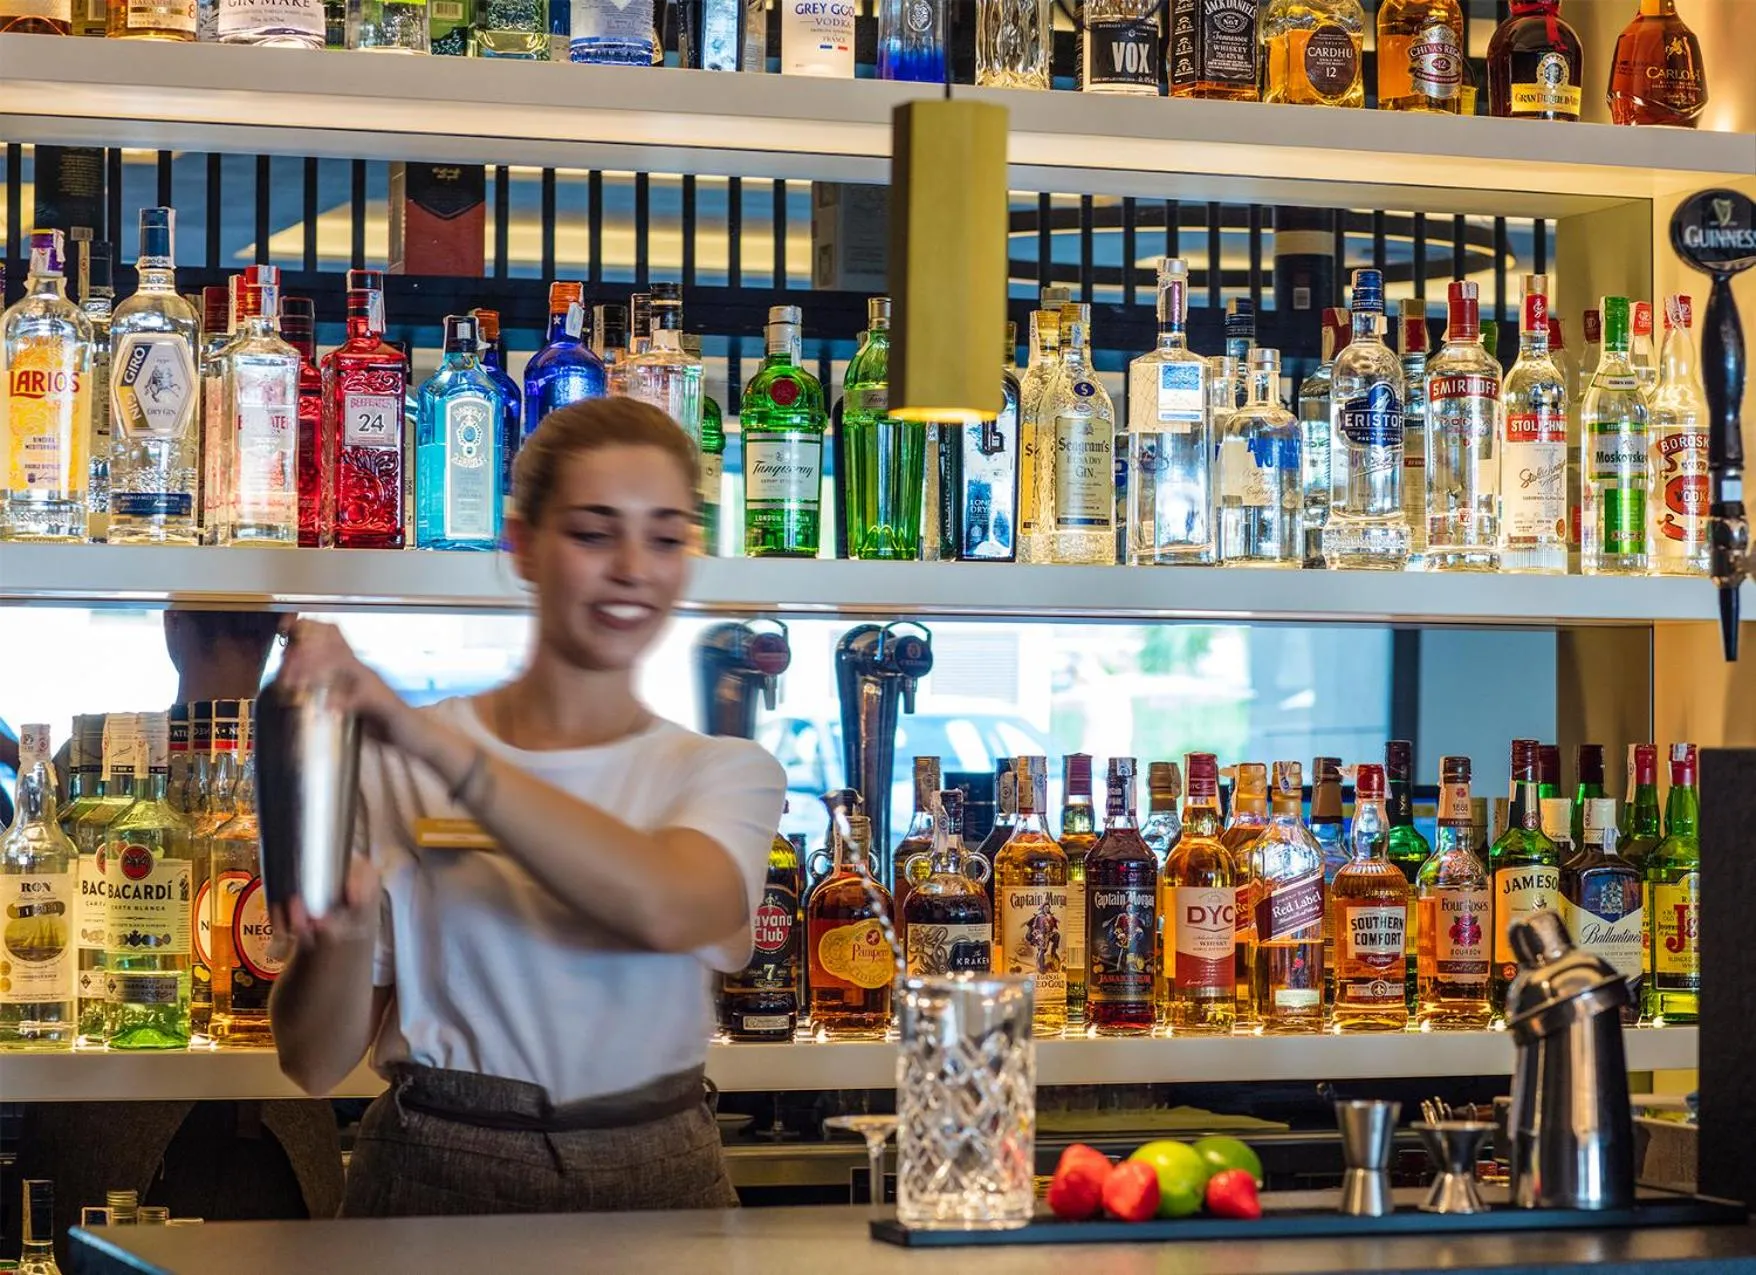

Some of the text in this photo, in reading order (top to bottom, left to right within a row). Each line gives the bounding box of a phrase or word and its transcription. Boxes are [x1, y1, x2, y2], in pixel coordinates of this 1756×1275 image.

[795, 3, 827, 15] GREY
[1112, 42, 1151, 74] VOX
[1308, 47, 1354, 59] CARDHU
[1326, 66, 1337, 78] 12
[1646, 66, 1694, 80] CARLO
[1684, 226, 1756, 248] GUINNES
[123, 346, 146, 385] GIRO
[10, 370, 80, 399] LARIOS
[1432, 379, 1498, 398] SMIRNOFF
[127, 392, 142, 421] GIN
[359, 413, 385, 432] 24
[1058, 436, 1110, 455] Seagram's
[1660, 435, 1710, 454] BORSK
[753, 461, 814, 479] Tanqueay
[21, 882, 52, 893] RON
[108, 880, 173, 901] BACARDÍ
[1503, 875, 1559, 894] JAMESO
[134, 904, 166, 912] BLANCA
[1010, 893, 1043, 910] Captain
[1094, 891, 1127, 909] Captain
[1272, 902, 1294, 918] Red
[1294, 891, 1322, 910] Label
[1441, 897, 1462, 912] Four
[754, 914, 794, 928] avana
[1187, 905, 1234, 925] DYC
[1351, 916, 1404, 931] SOUTHERN
[754, 929, 785, 944] Club
[1355, 932, 1402, 946] COMFORT
[764, 964, 776, 981] 7
